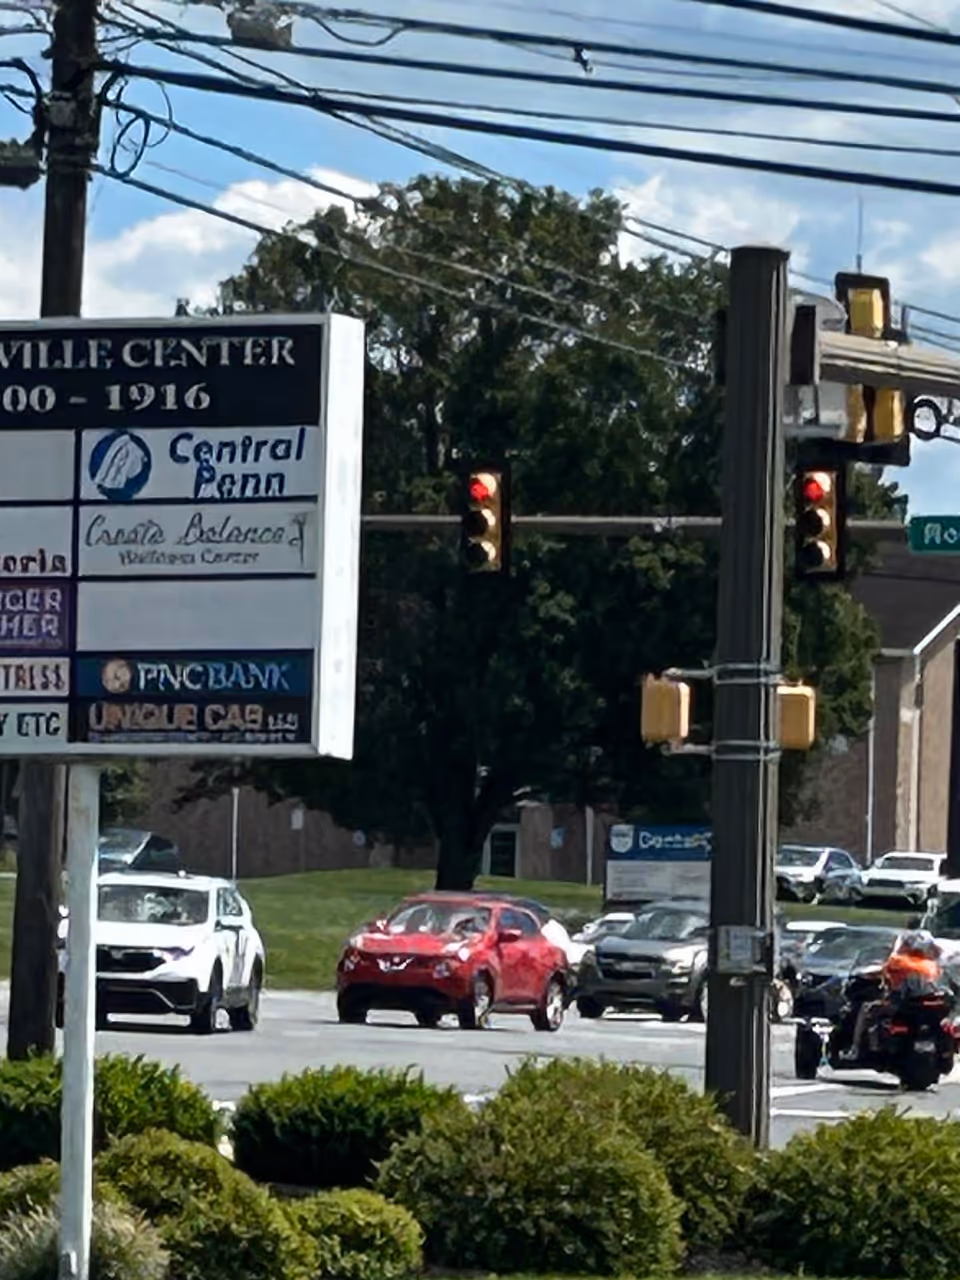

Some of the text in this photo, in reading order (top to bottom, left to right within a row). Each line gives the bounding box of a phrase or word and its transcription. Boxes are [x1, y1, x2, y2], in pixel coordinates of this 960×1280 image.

[121, 336, 296, 368] CENTER
[105, 382, 211, 411] 1916
[169, 427, 307, 464] Central
[194, 459, 286, 499] Penn
[16, 711, 62, 737] ETC
[88, 703, 198, 731] UNIQUE
